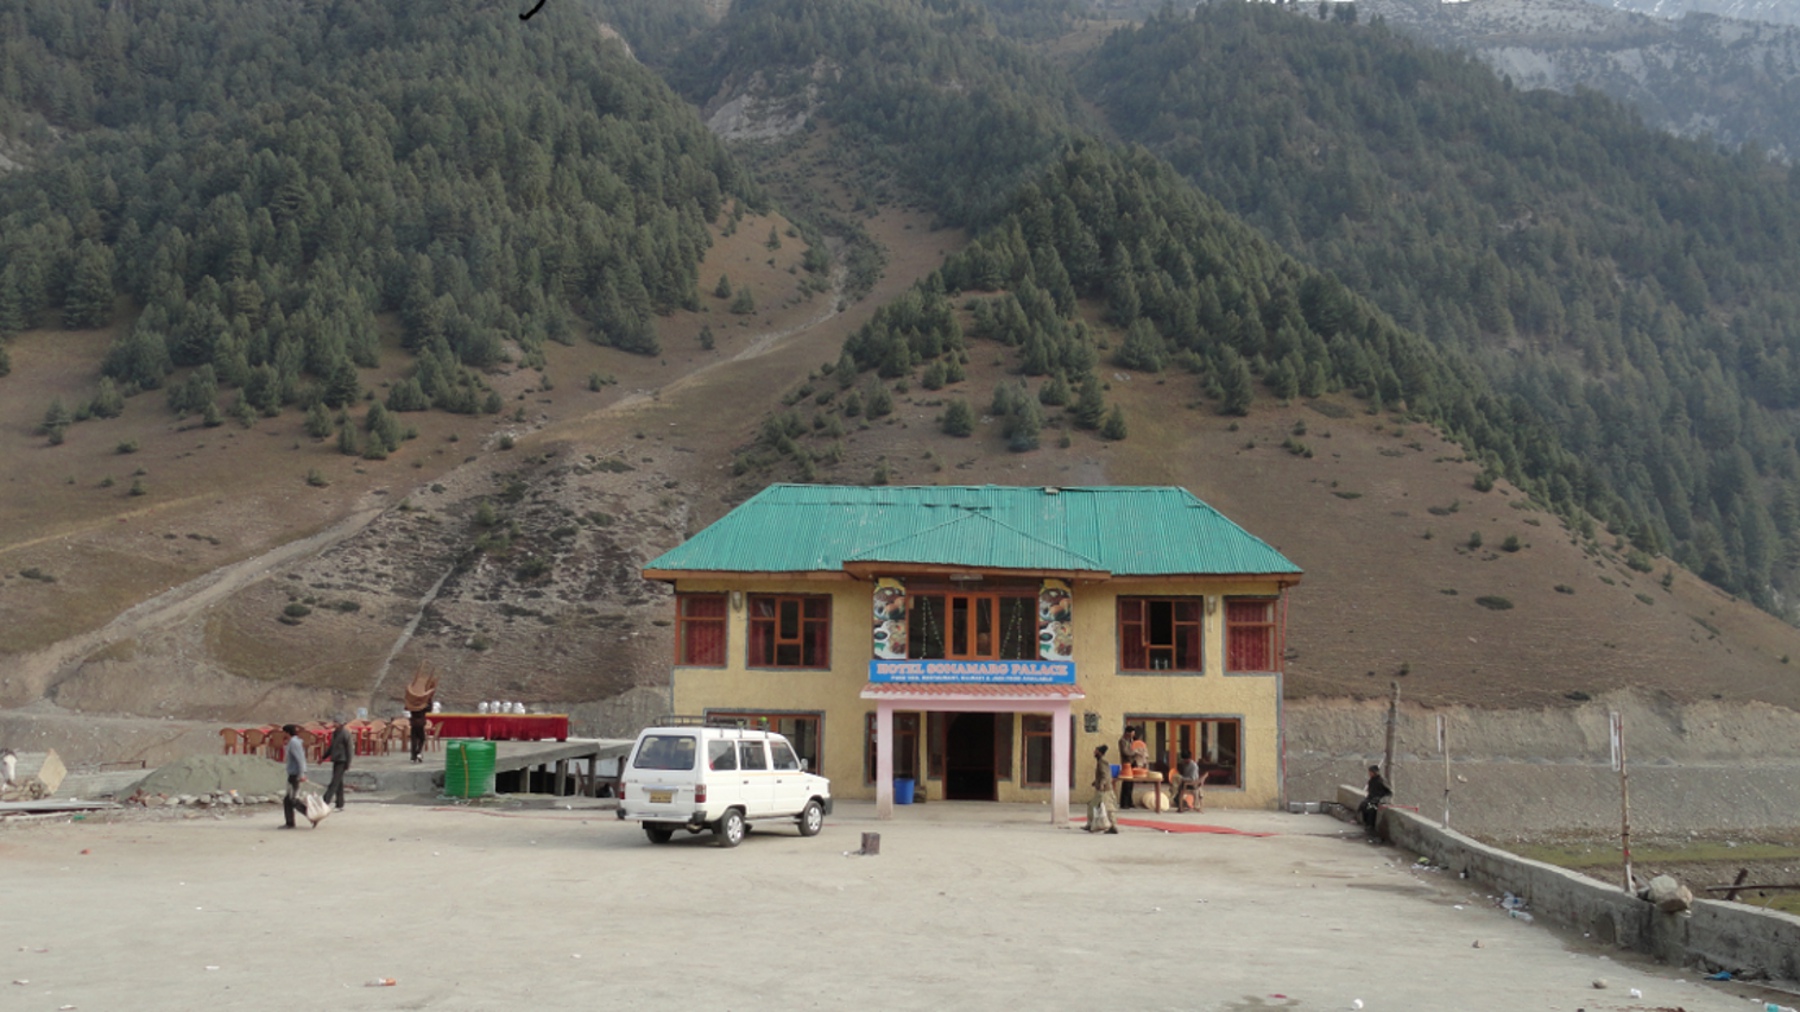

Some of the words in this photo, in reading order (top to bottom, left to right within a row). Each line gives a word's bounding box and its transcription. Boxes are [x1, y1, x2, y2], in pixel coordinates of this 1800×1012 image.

[876, 663, 925, 675] HOTEL
[927, 663, 1009, 675] SONAMARG
[1011, 663, 1068, 677] PALACE
